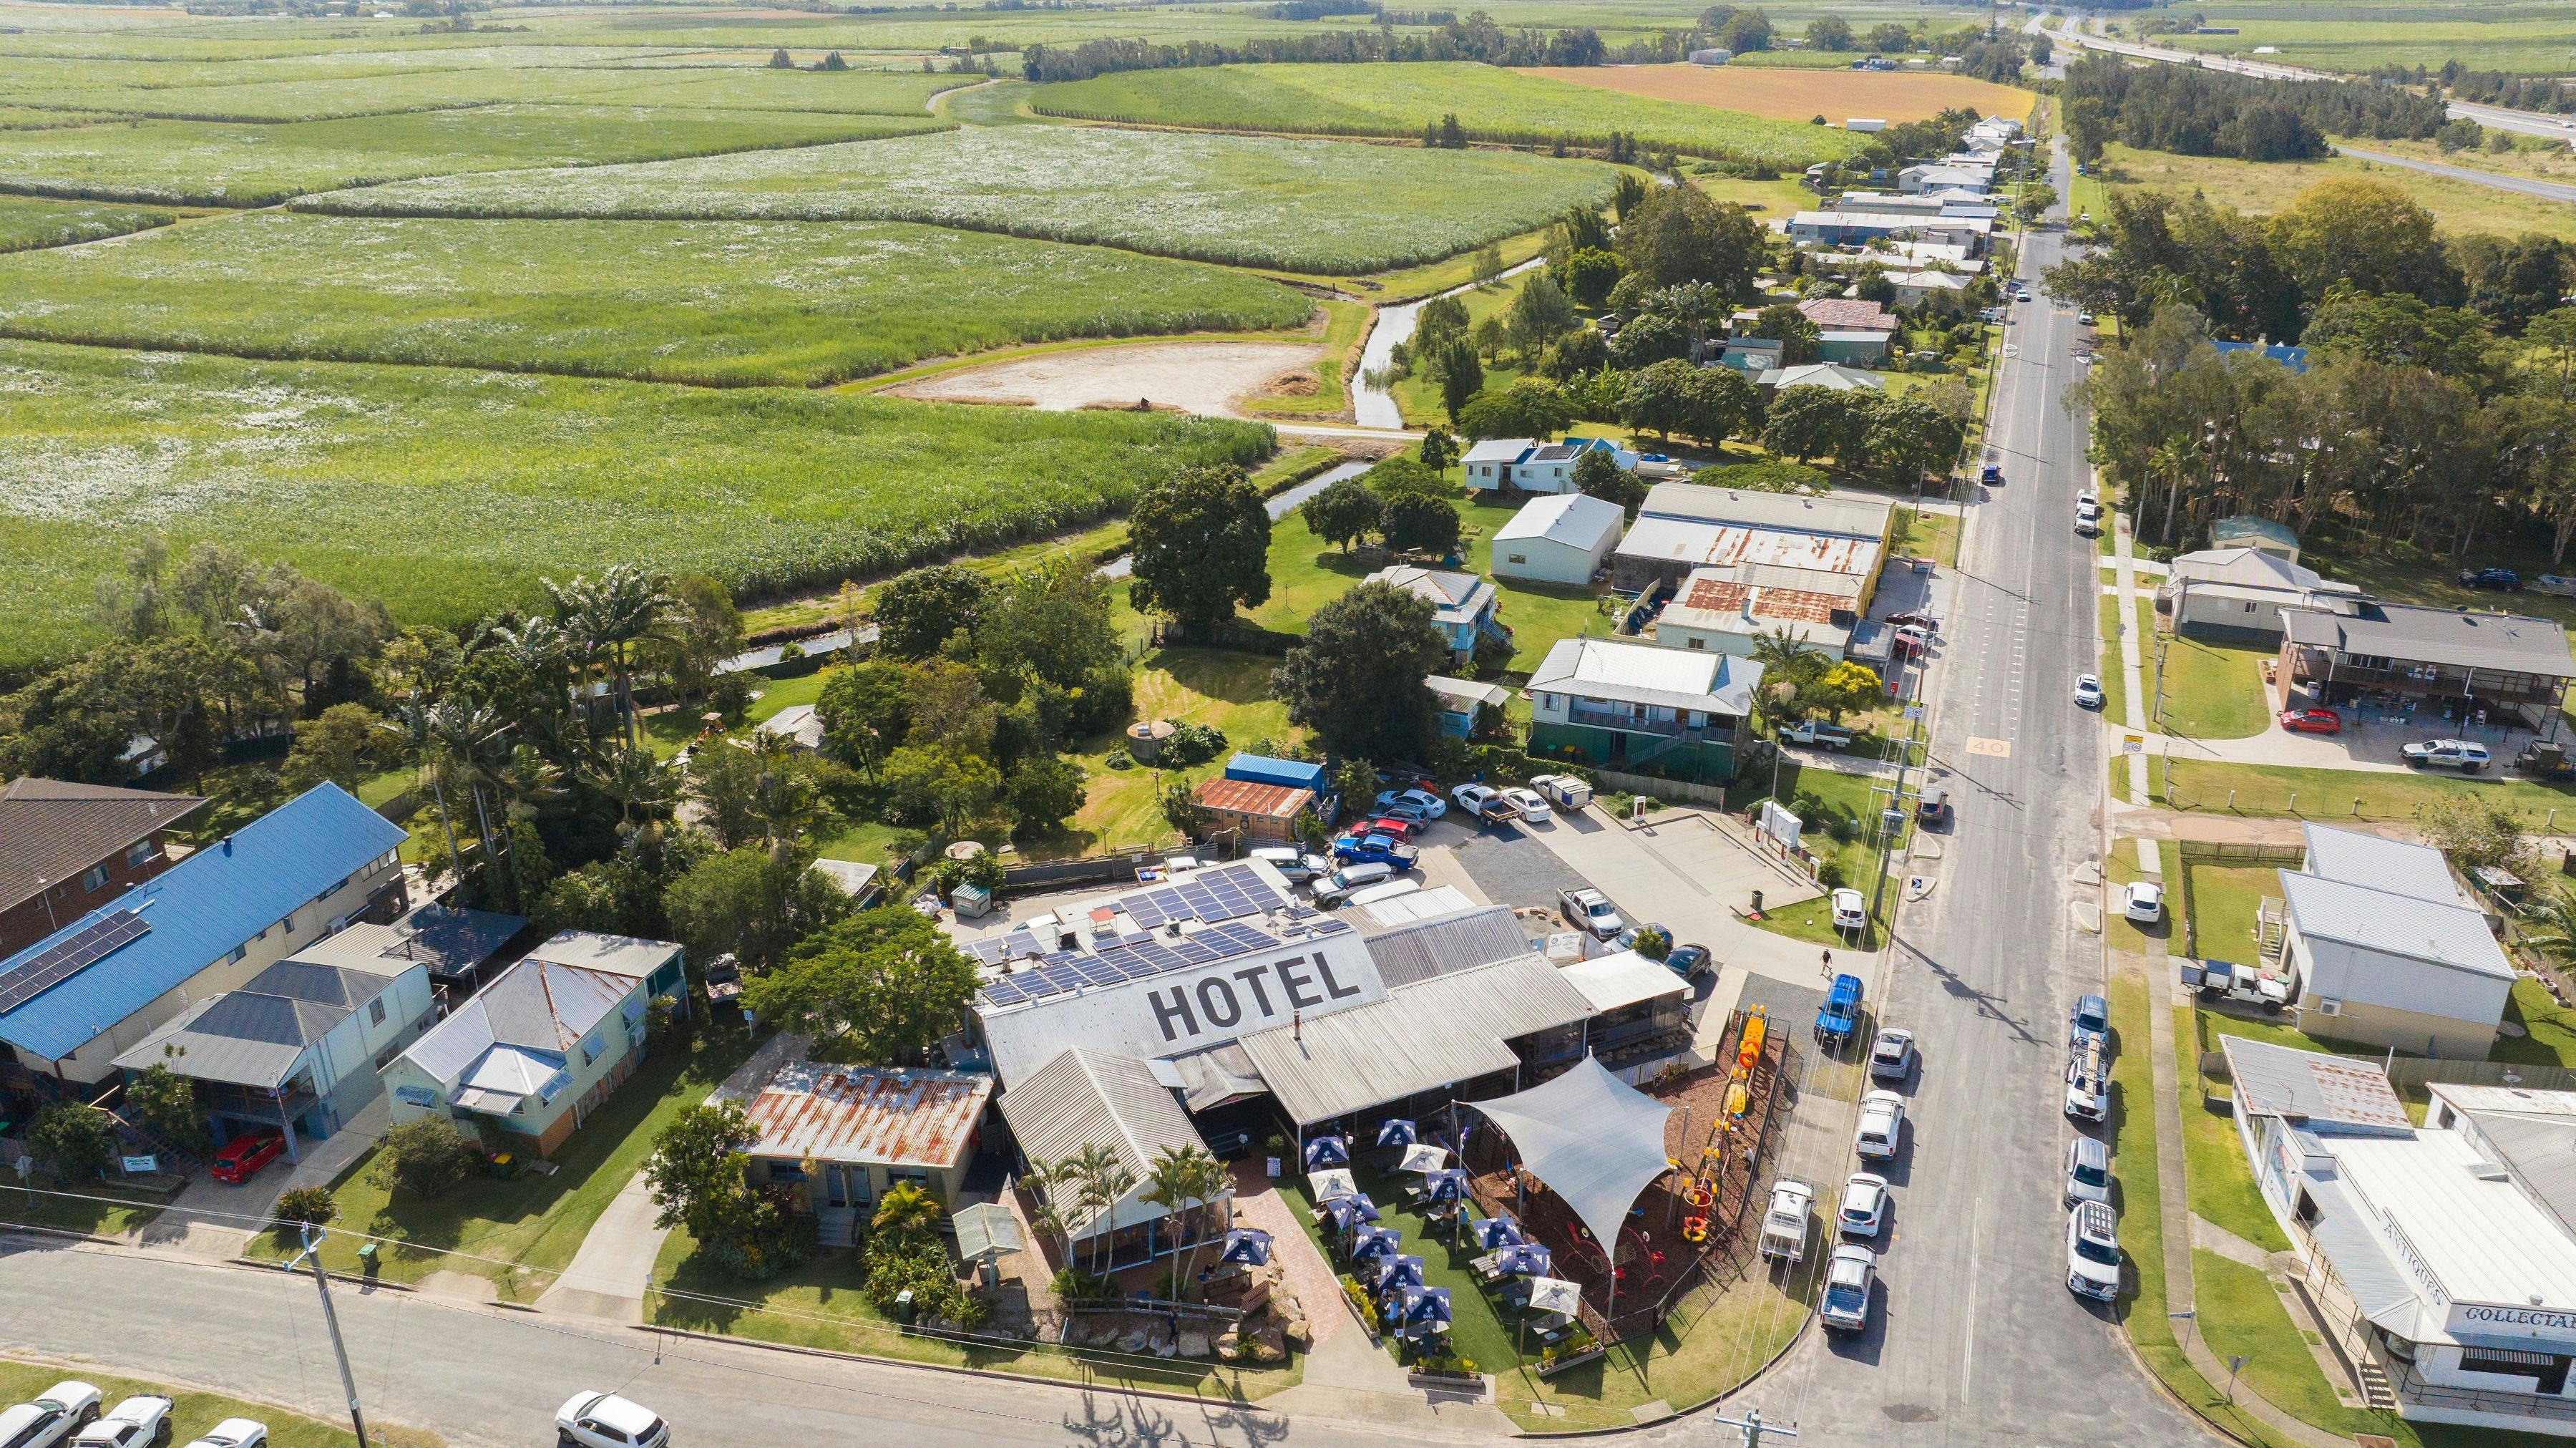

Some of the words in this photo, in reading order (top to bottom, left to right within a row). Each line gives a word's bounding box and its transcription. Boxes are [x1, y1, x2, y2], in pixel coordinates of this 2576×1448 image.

[1973, 741, 2004, 753] 40
[1147, 951, 1361, 1041] HOTEL
[2384, 1223, 2443, 1306] ANTIQUES
